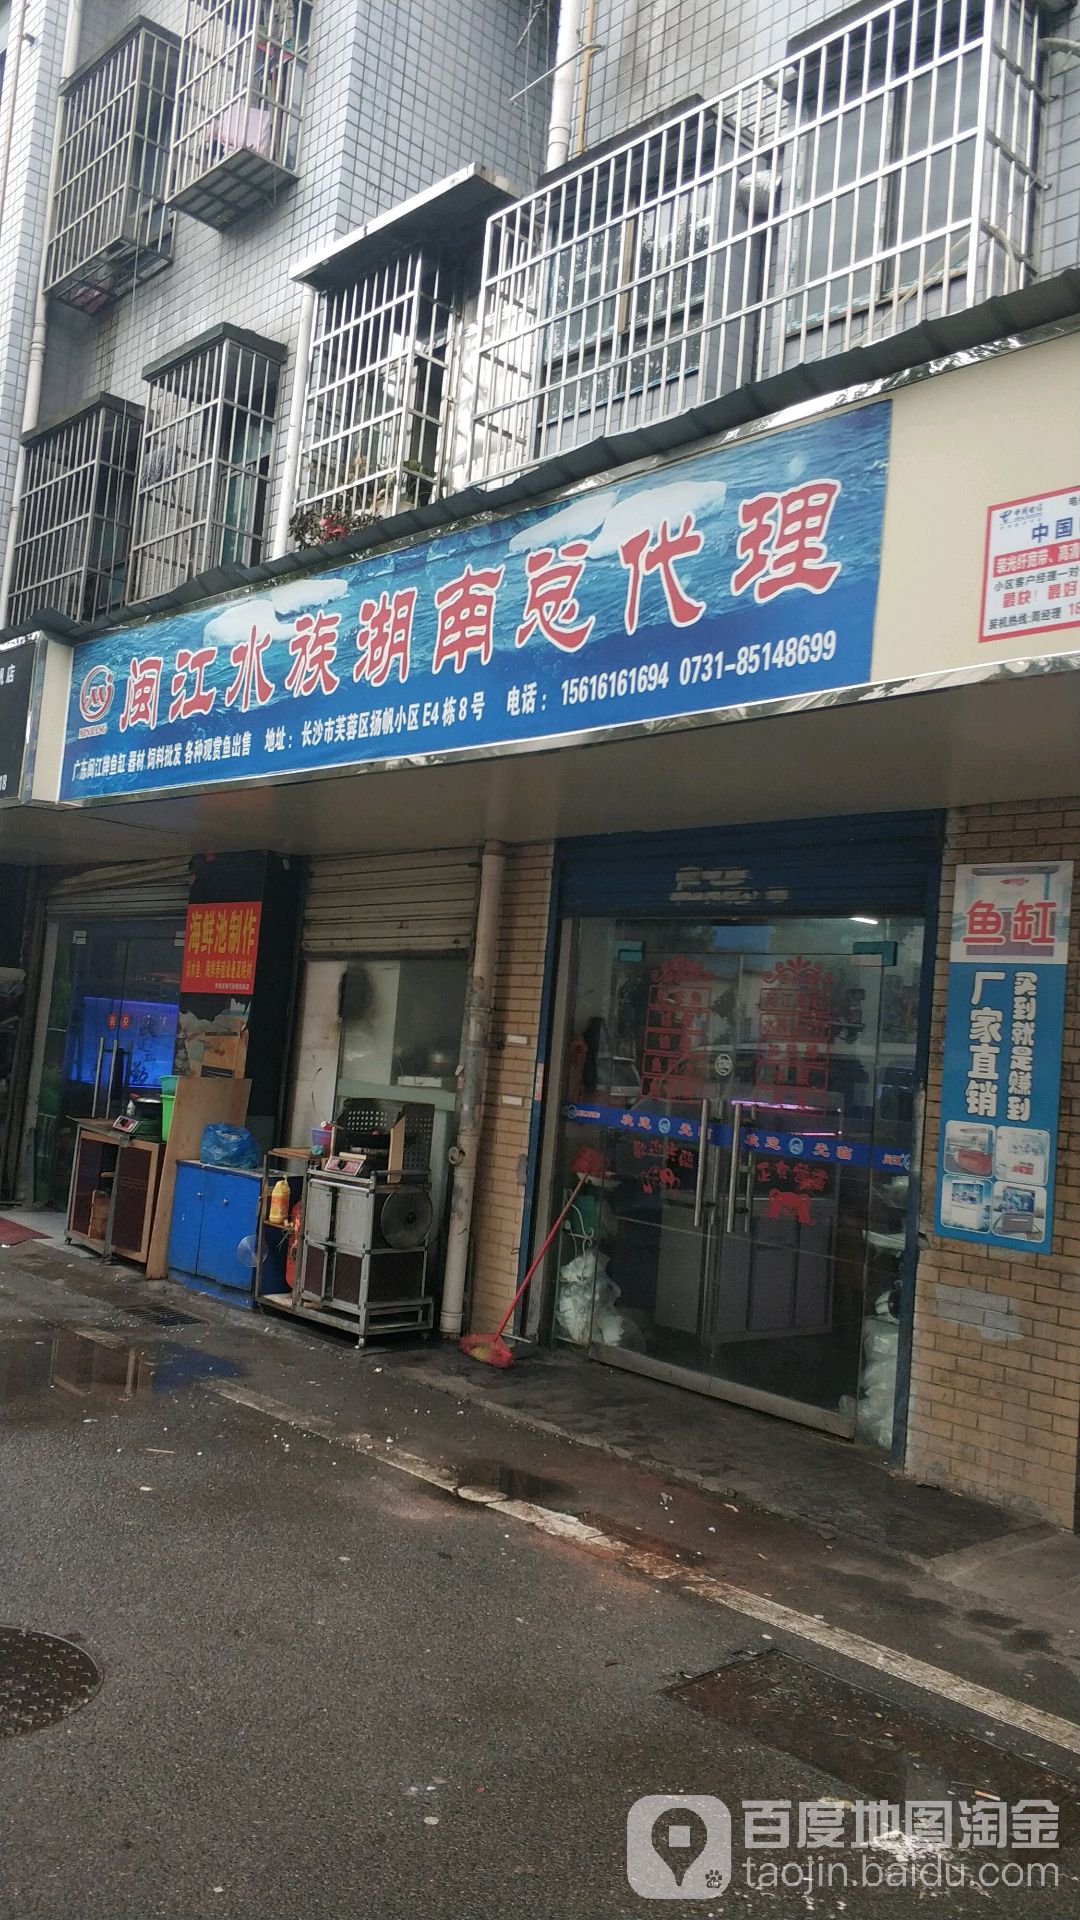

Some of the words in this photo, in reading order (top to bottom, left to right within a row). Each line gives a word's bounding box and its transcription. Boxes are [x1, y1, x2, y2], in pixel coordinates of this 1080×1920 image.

[1031, 517, 1080, 543] 中国
[119, 478, 842, 733] 闽江水族湖南总代理
[561, 662, 670, 706] 15616161694
[679, 630, 838, 686] 0731-85148699
[188, 908, 257, 955] 海鲜池制作
[961, 899, 1058, 946] 鱼缸
[964, 971, 1006, 1119] 厂家直销
[1006, 971, 1038, 1123] 买到就是赚到
